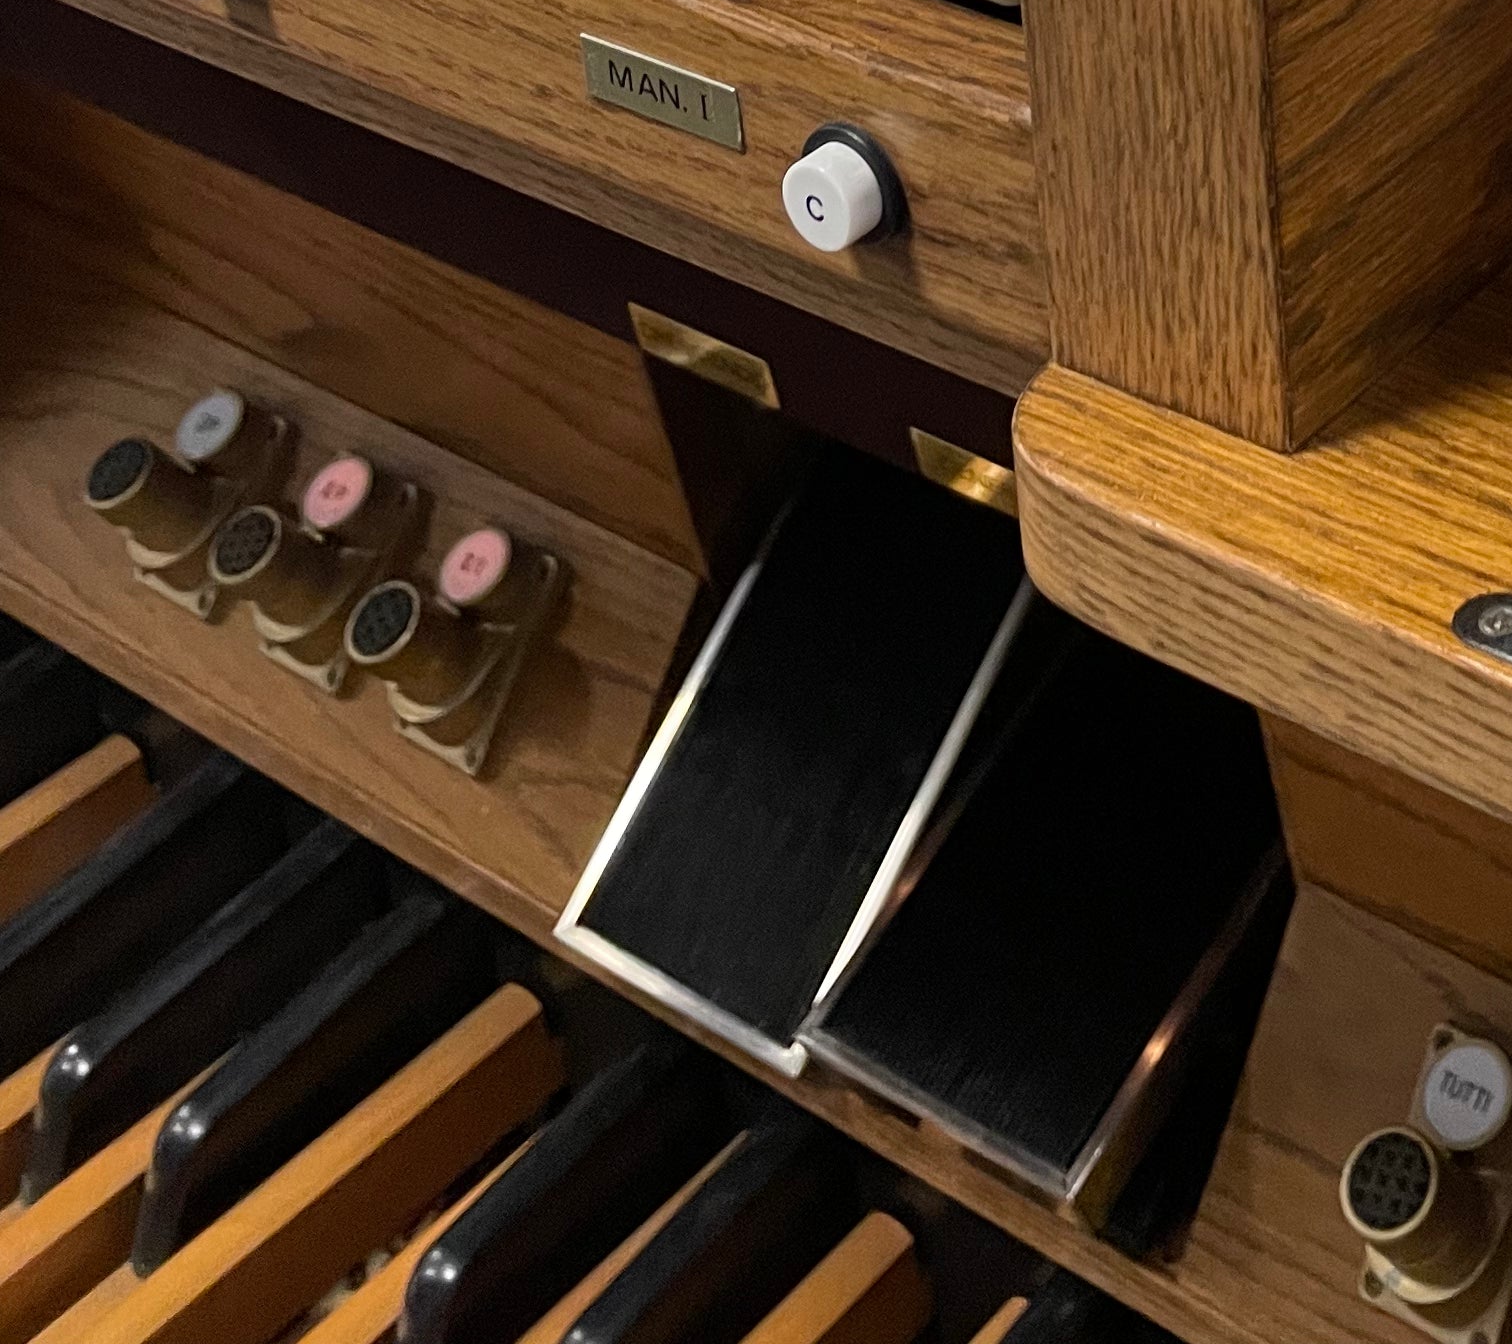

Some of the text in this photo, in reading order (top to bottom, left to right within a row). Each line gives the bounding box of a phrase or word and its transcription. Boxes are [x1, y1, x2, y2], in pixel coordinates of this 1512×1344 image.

[608, 59, 710, 122] MAN. I
[806, 195, 825, 222] C
